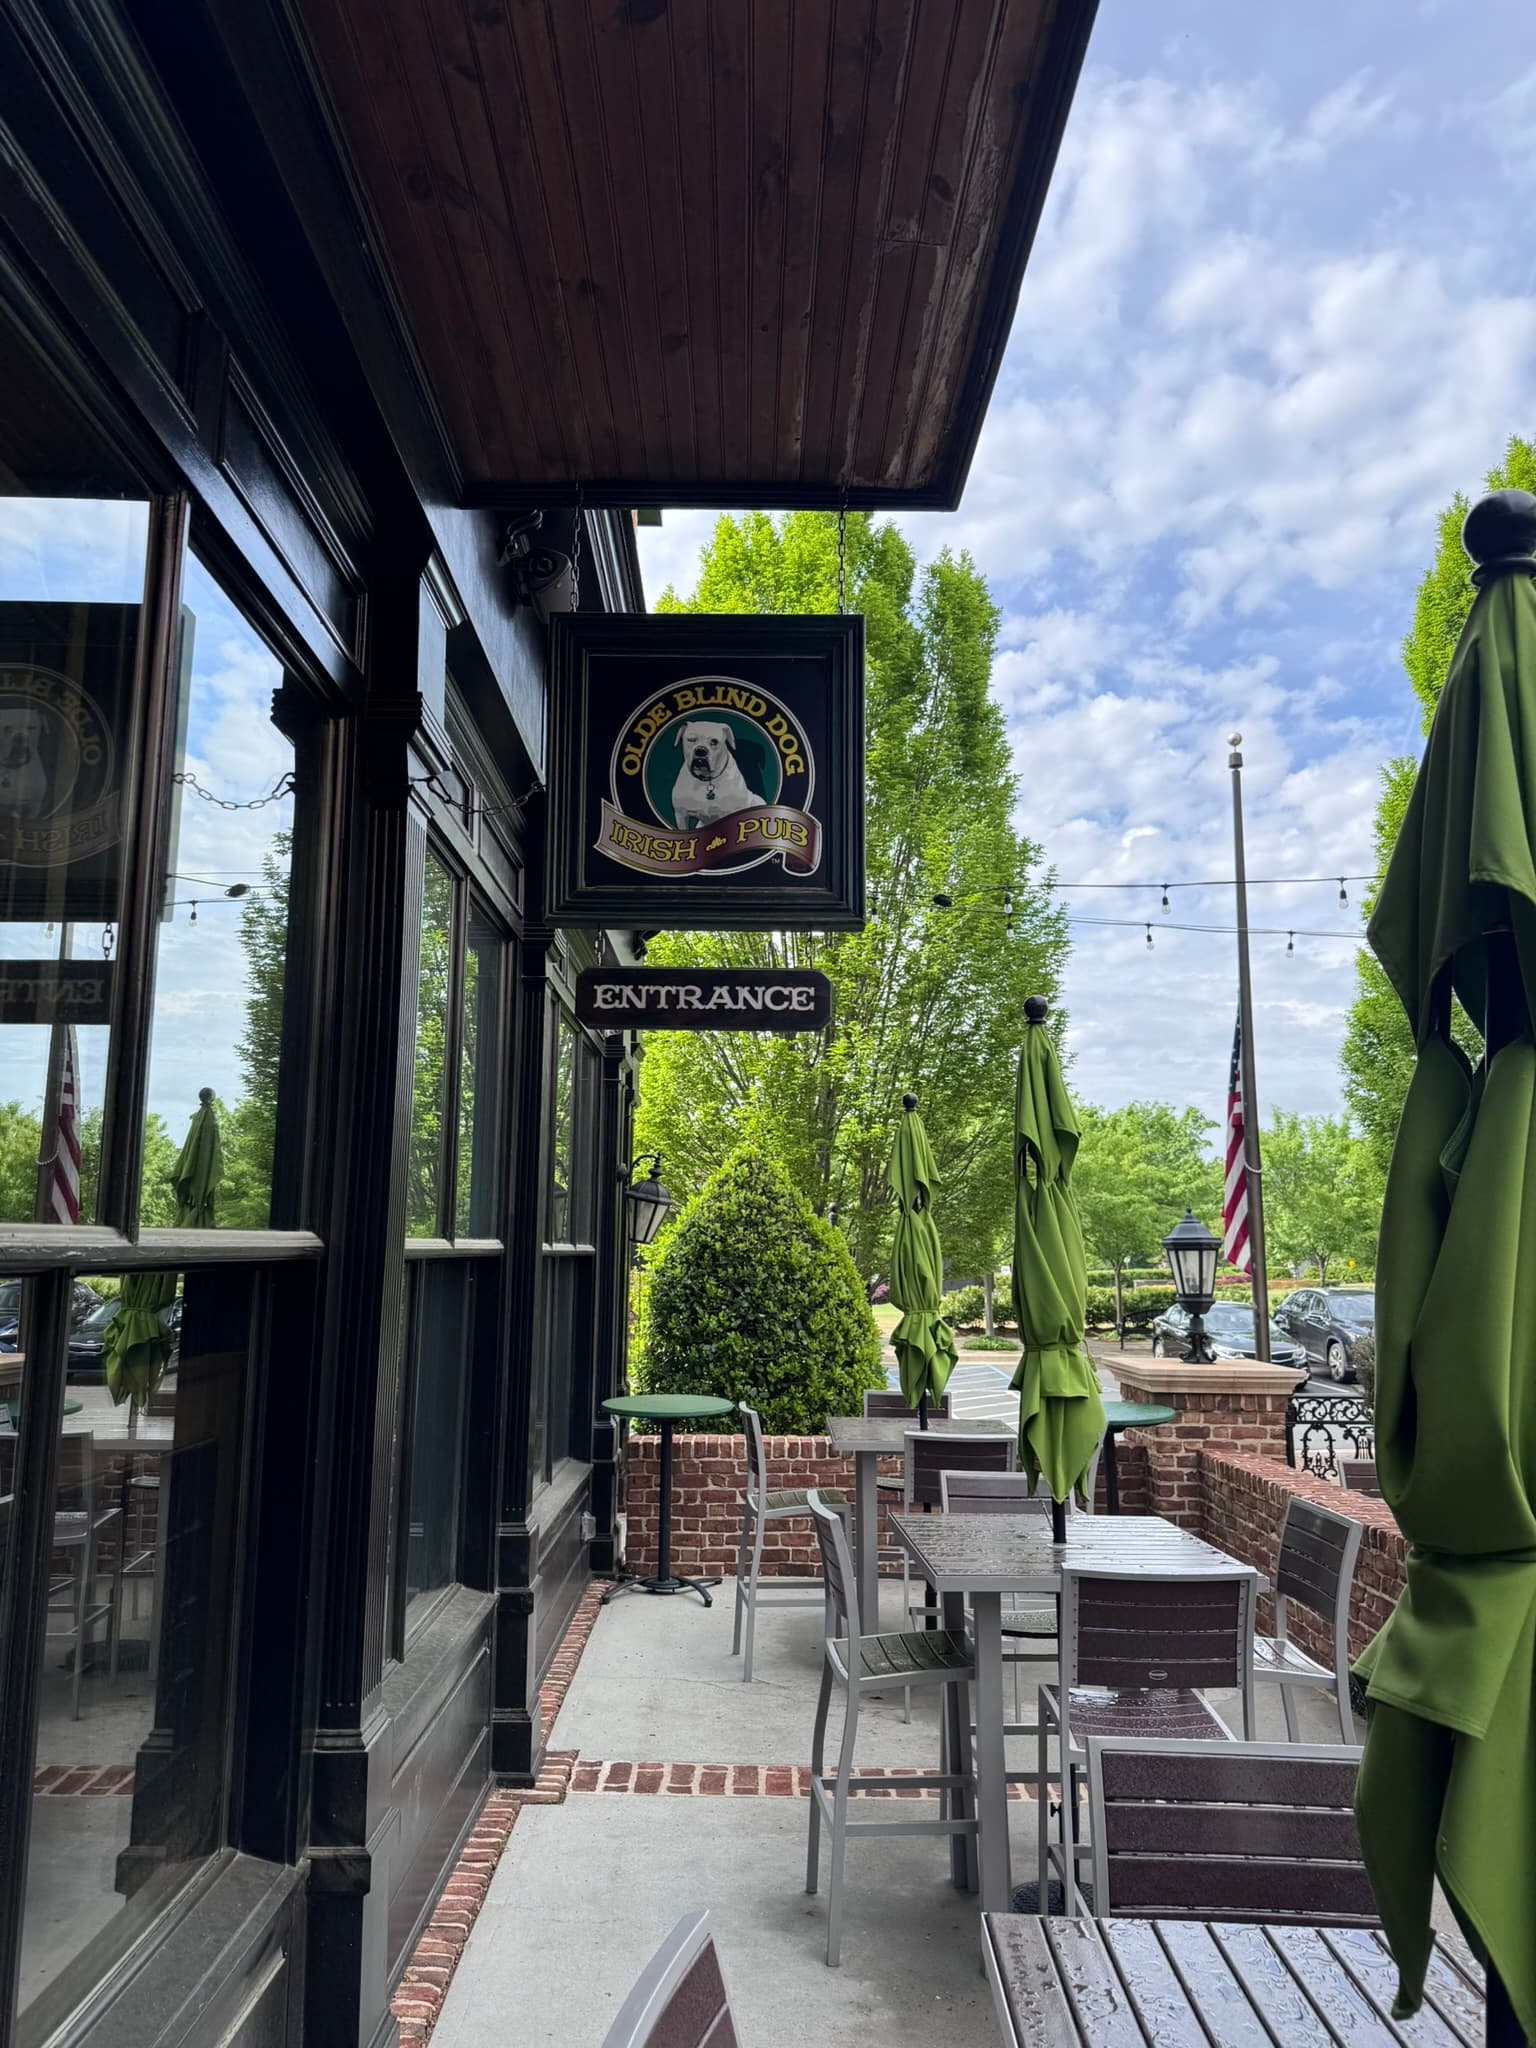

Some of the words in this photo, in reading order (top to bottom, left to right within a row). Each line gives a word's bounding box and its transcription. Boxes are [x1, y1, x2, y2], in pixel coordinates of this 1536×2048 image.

[621, 702, 672, 776] OLDE
[673, 686, 767, 718] BLIND
[765, 713, 805, 777] DOG
[609, 819, 698, 862] IRISH
[735, 816, 809, 848] PUB
[593, 984, 816, 1011] ENTRANCE
